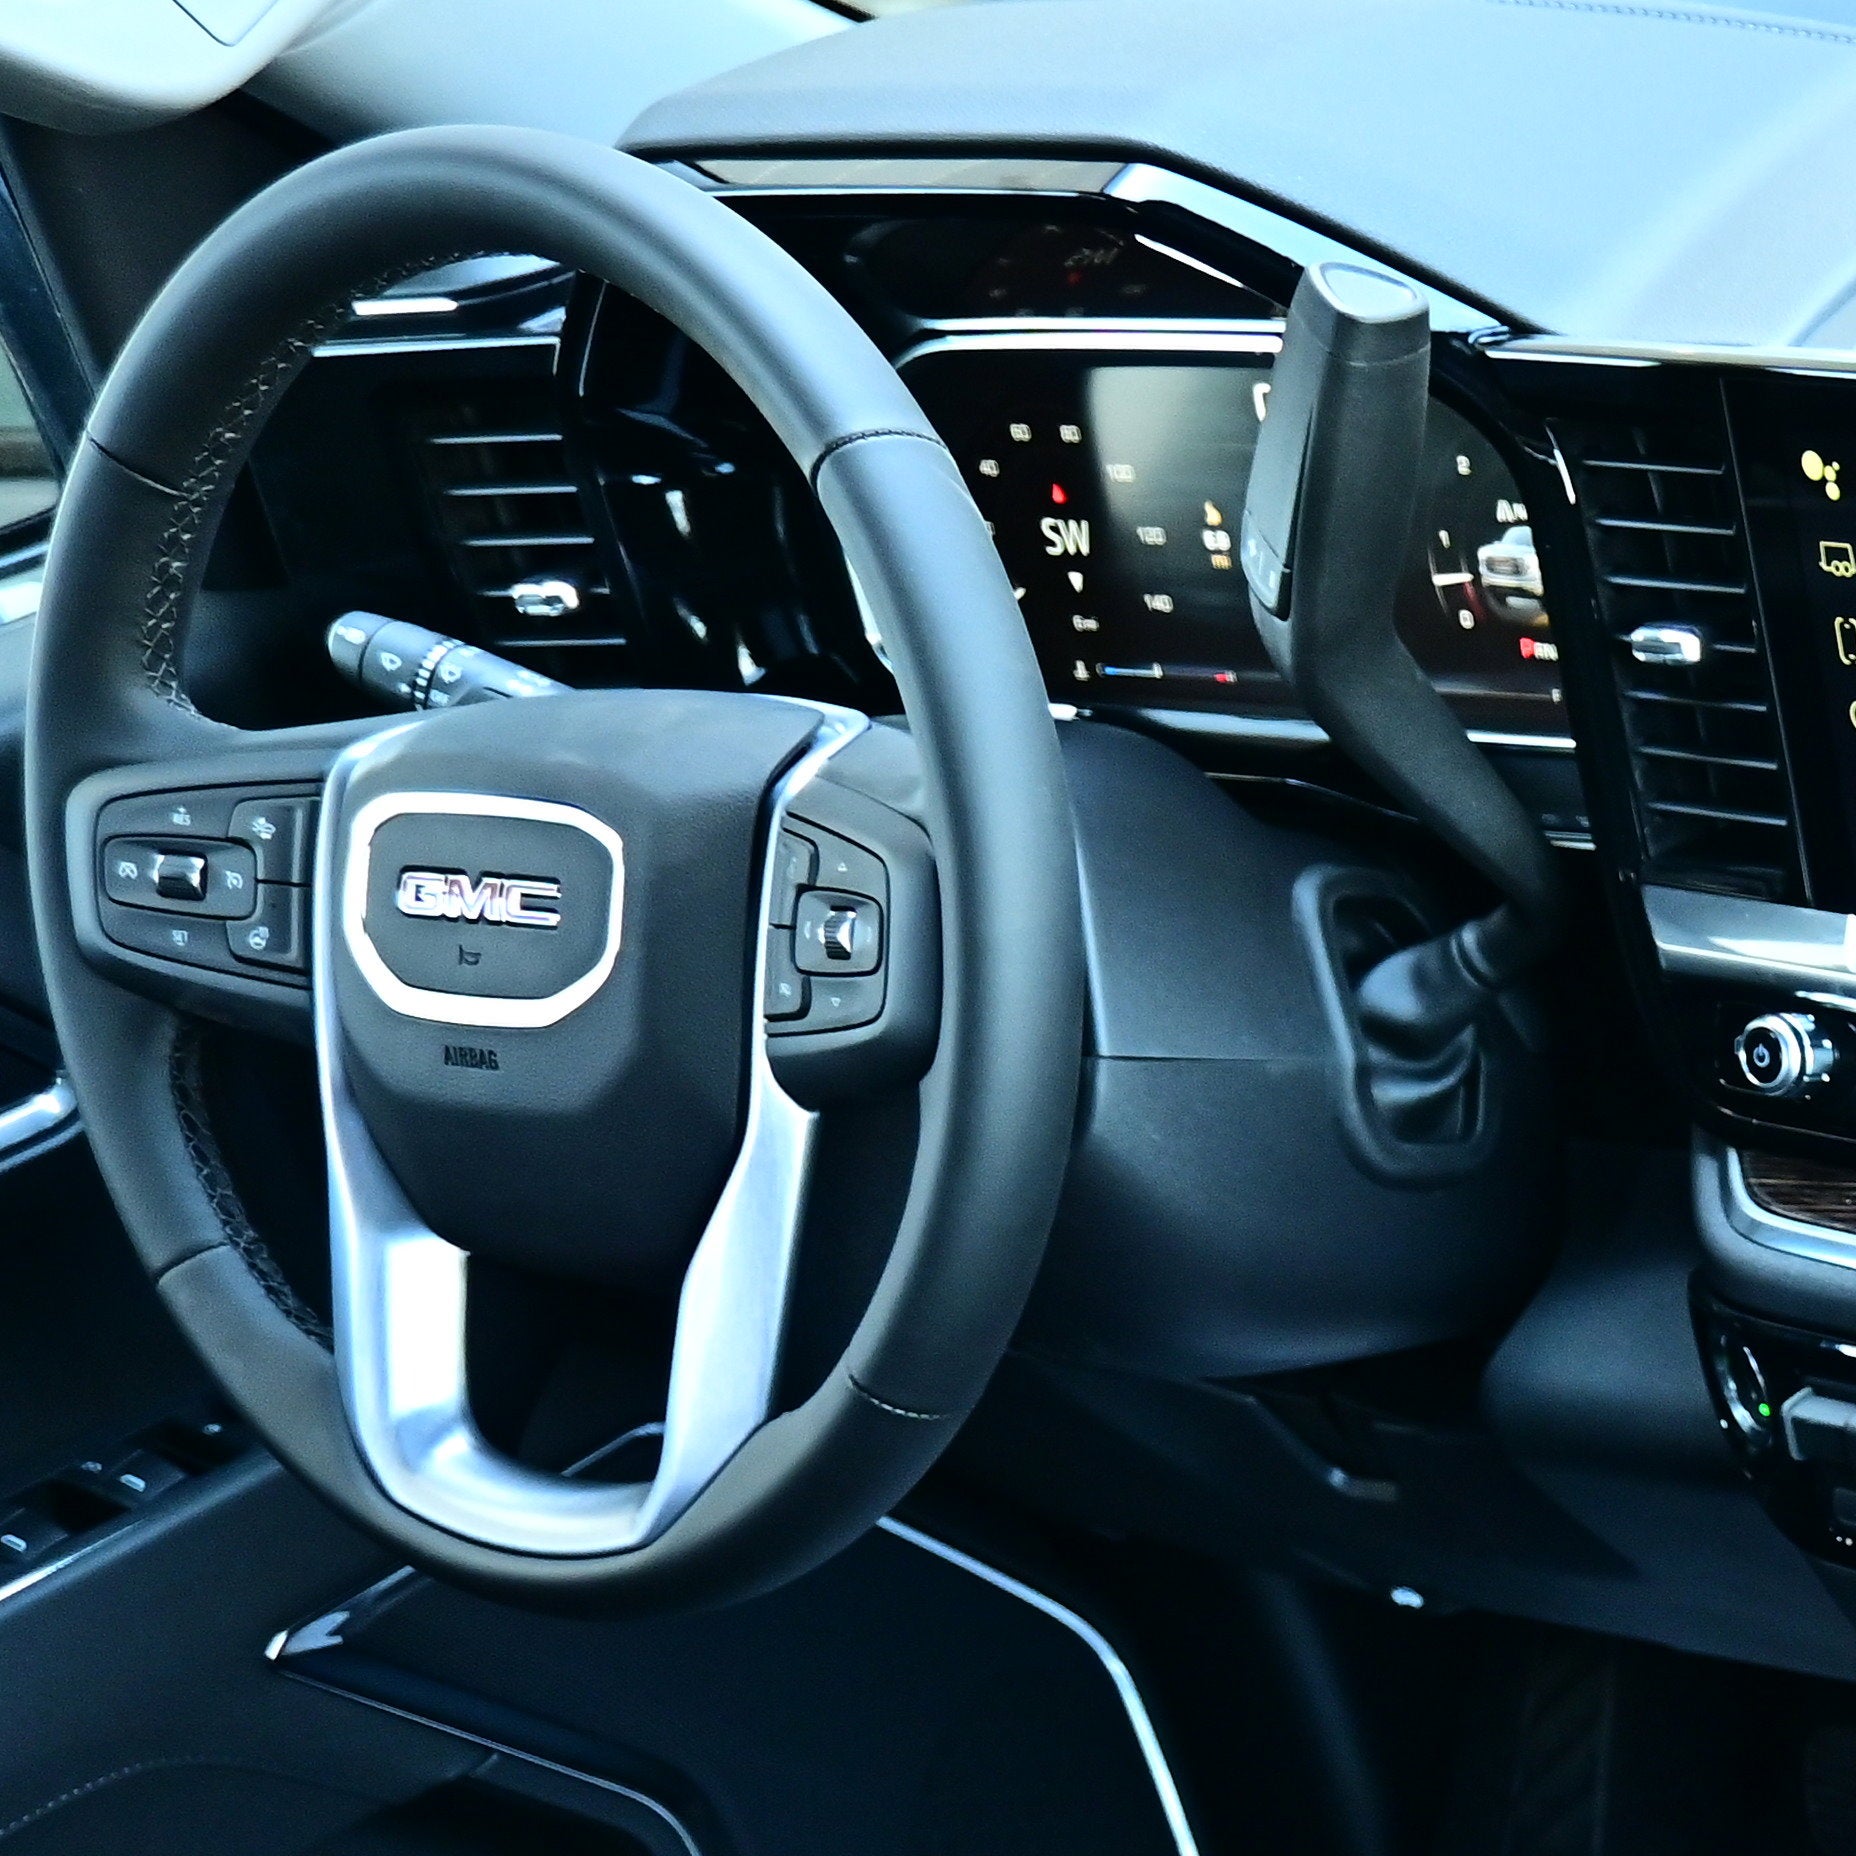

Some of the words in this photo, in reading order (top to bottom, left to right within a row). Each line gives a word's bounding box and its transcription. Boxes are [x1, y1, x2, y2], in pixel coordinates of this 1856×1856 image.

[1040, 516, 1090, 556] SW
[396, 871, 562, 926] GMC
[444, 1045, 499, 1071] AIRBAG
